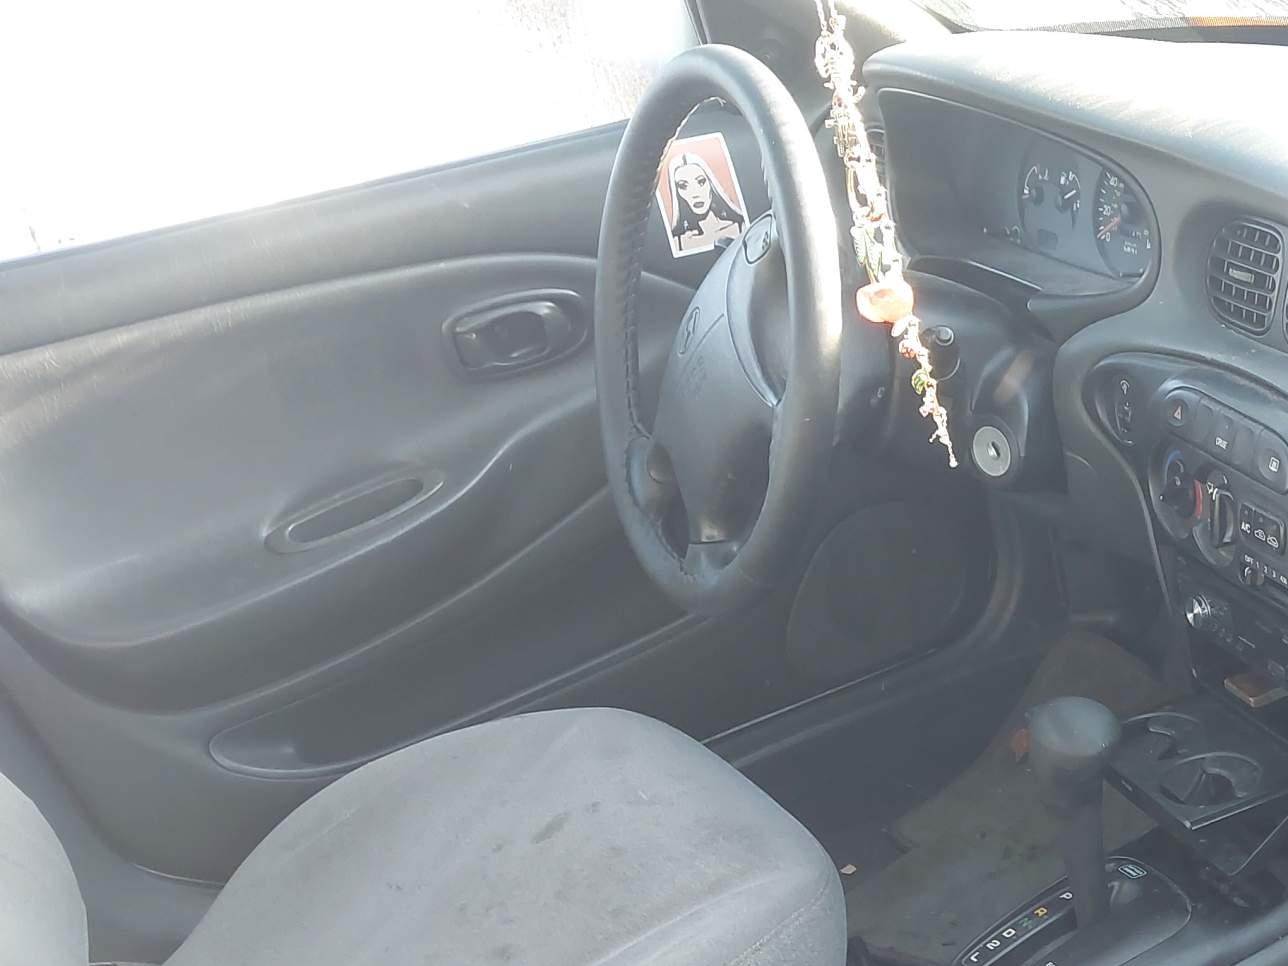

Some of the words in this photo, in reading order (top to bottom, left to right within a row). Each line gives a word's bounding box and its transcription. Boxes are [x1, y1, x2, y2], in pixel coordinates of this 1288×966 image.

[1059, 891, 1073, 901] P
[1034, 906, 1048, 918] R
[1002, 928, 1017, 938] D
[985, 939, 1001, 950] 2
[969, 951, 980, 962] L
